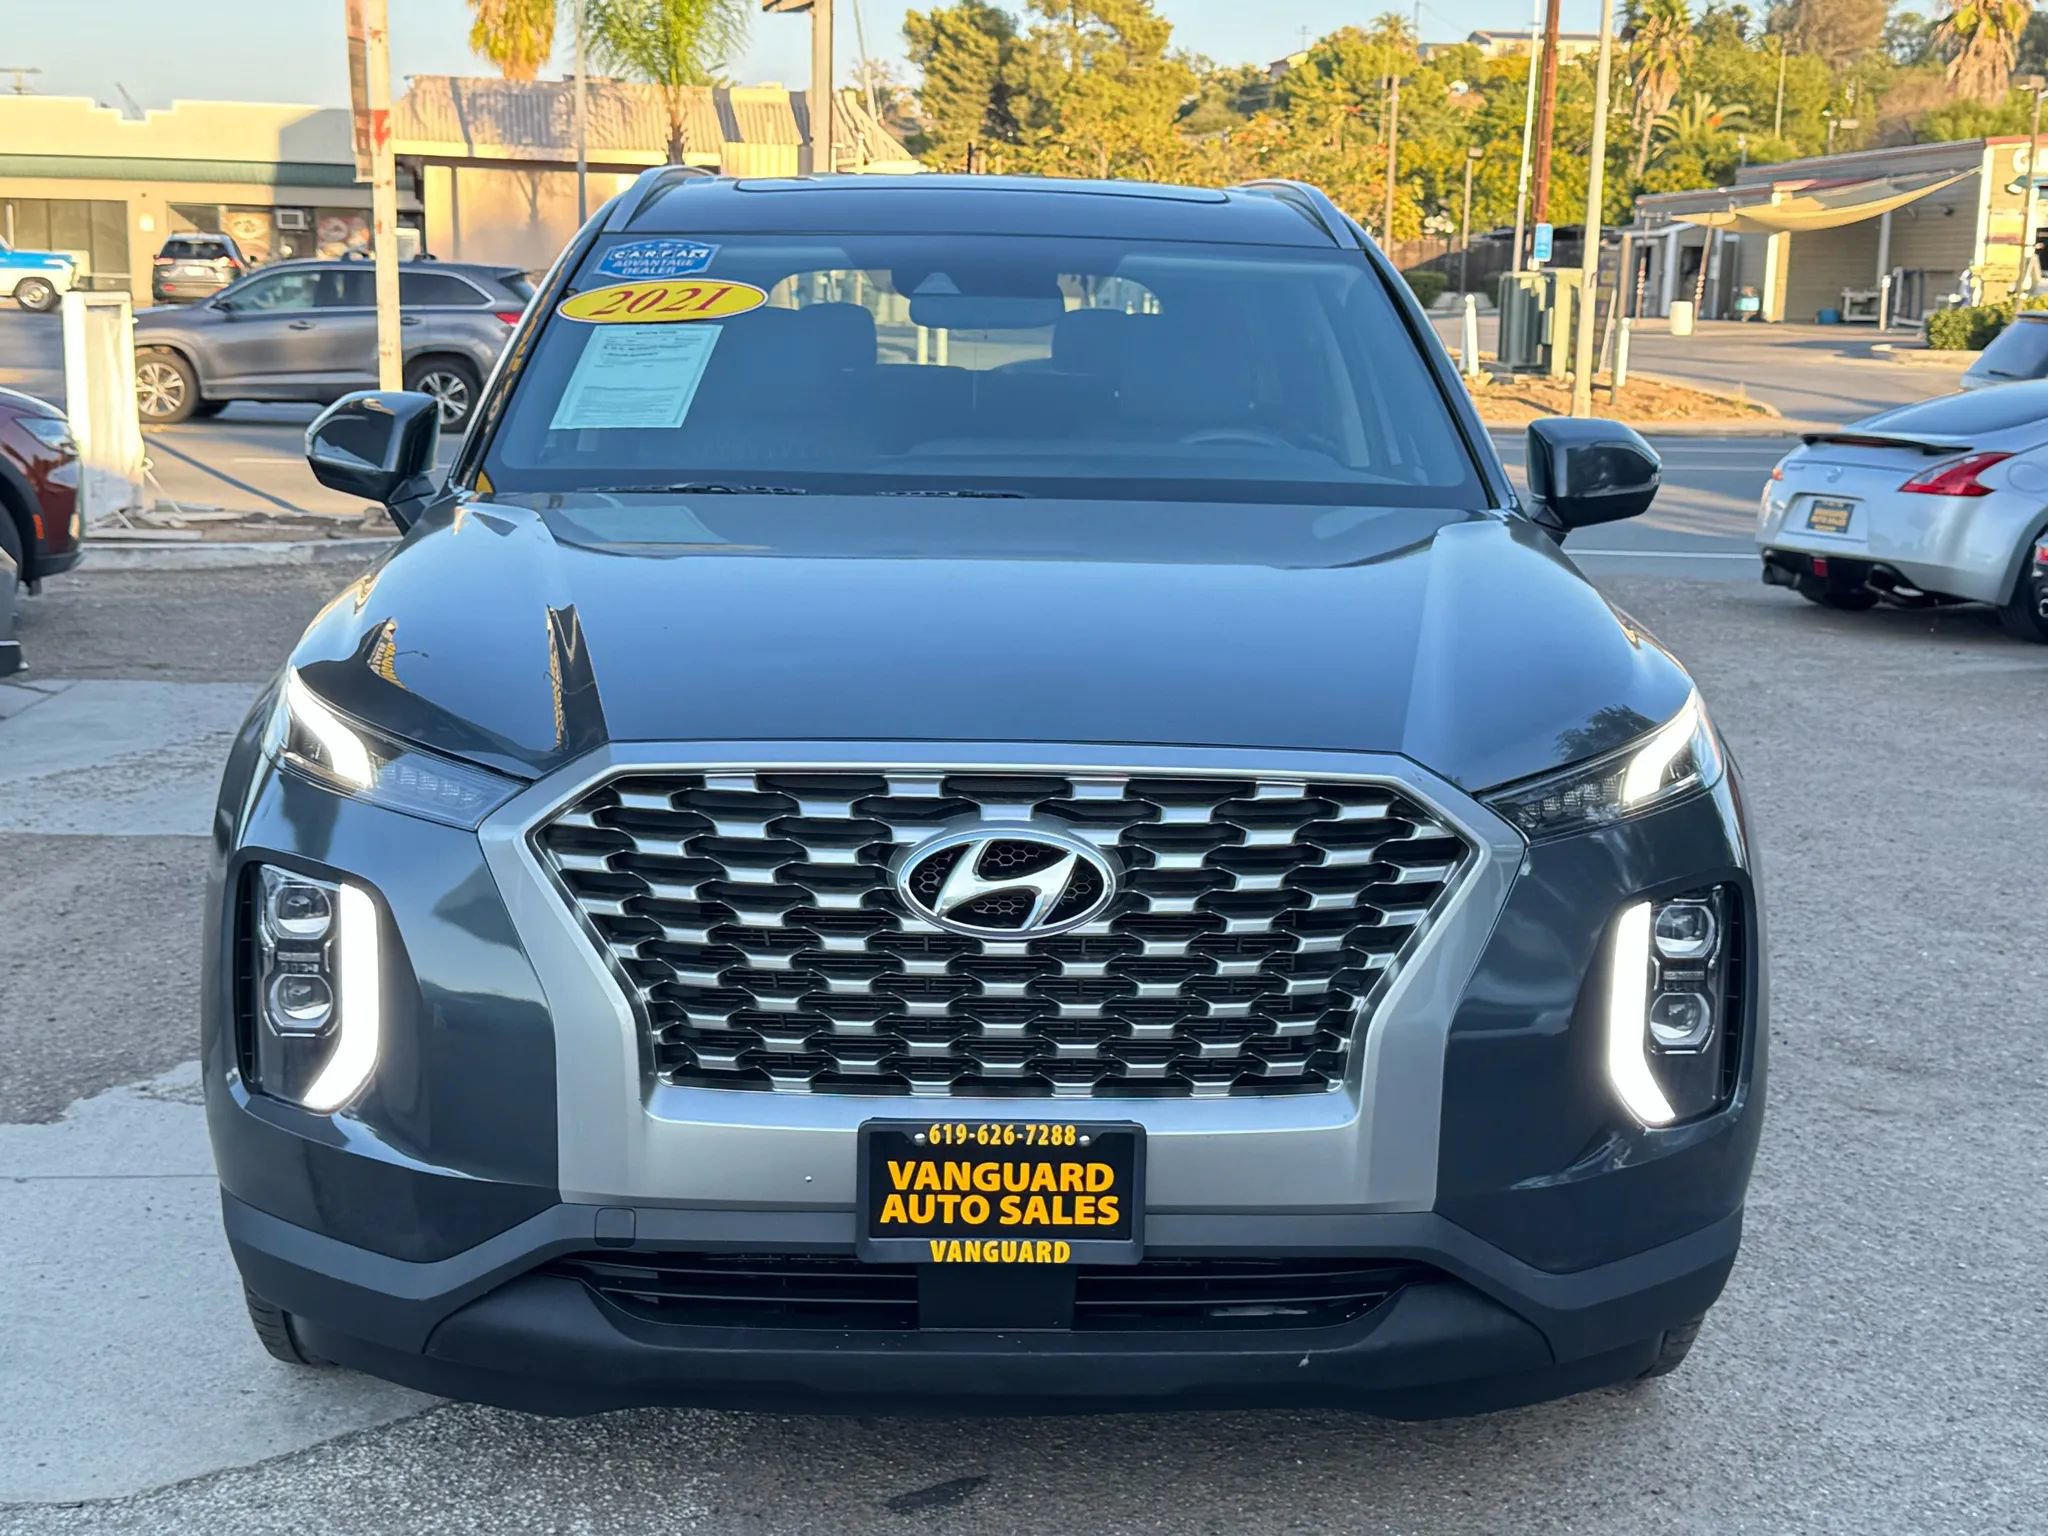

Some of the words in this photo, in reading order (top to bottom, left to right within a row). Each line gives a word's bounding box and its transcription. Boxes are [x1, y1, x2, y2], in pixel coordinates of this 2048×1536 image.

[612, 259, 694, 268] ADVANTAGE
[622, 266, 676, 275] DEALER
[588, 287, 733, 317] 2021
[928, 1123, 1076, 1146] 619-626-7288
[887, 1160, 1115, 1193] VANGUARD
[880, 1193, 990, 1224] AUTO
[999, 1195, 1119, 1226] SALES
[929, 1240, 1071, 1264] VANGUARD
